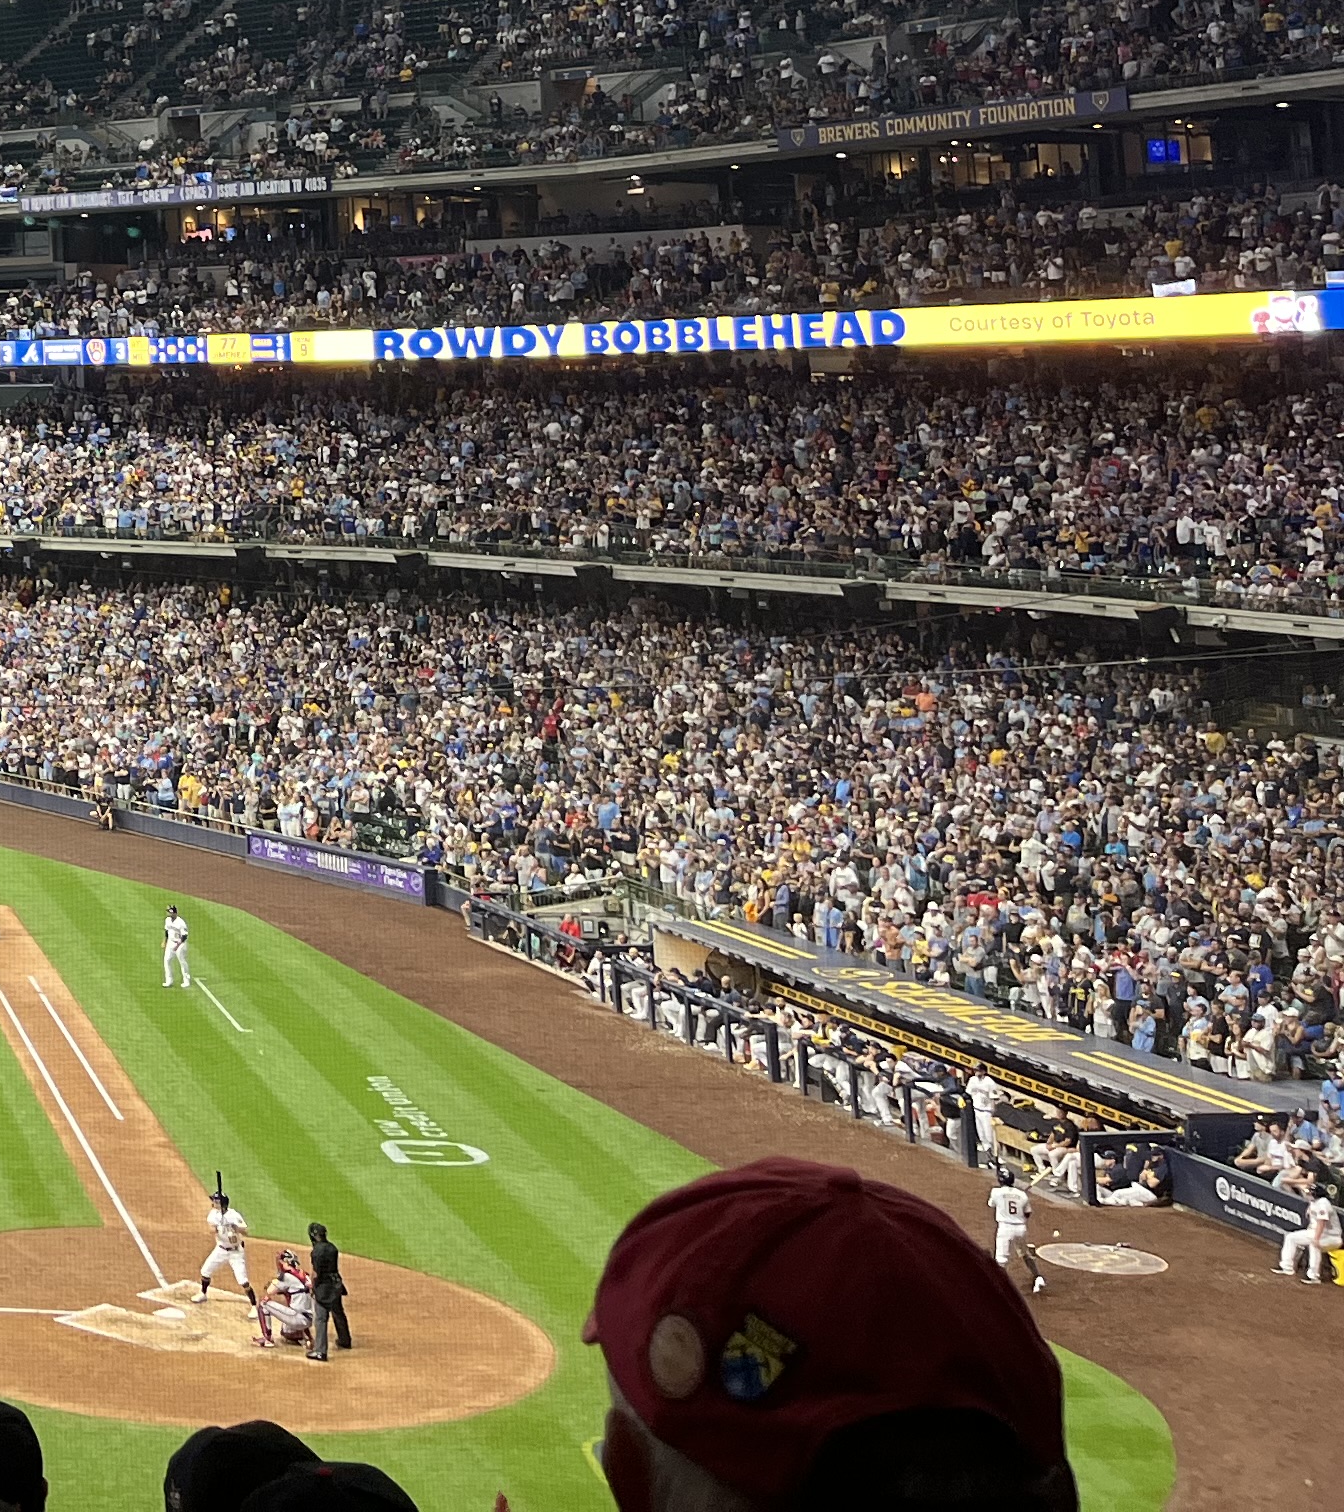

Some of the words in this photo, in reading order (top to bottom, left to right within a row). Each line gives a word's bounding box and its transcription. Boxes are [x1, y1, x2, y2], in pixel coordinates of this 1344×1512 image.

[818, 120, 880, 145] BREWERS
[886, 109, 971, 136] COMMUNITY
[979, 97, 1076, 125] FOUNDATION
[220, 338, 237, 350] 77
[372, 325, 566, 361] ROWDY
[583, 309, 906, 356] BOBBLEHEAD
[949, 314, 1044, 333] Courtesy
[1052, 311, 1073, 329] of
[1081, 309, 1155, 331] Toyota
[115, 342, 126, 360] 3
[1008, 1201, 1017, 1215] 6
[1231, 1185, 1302, 1226] fairway.com
